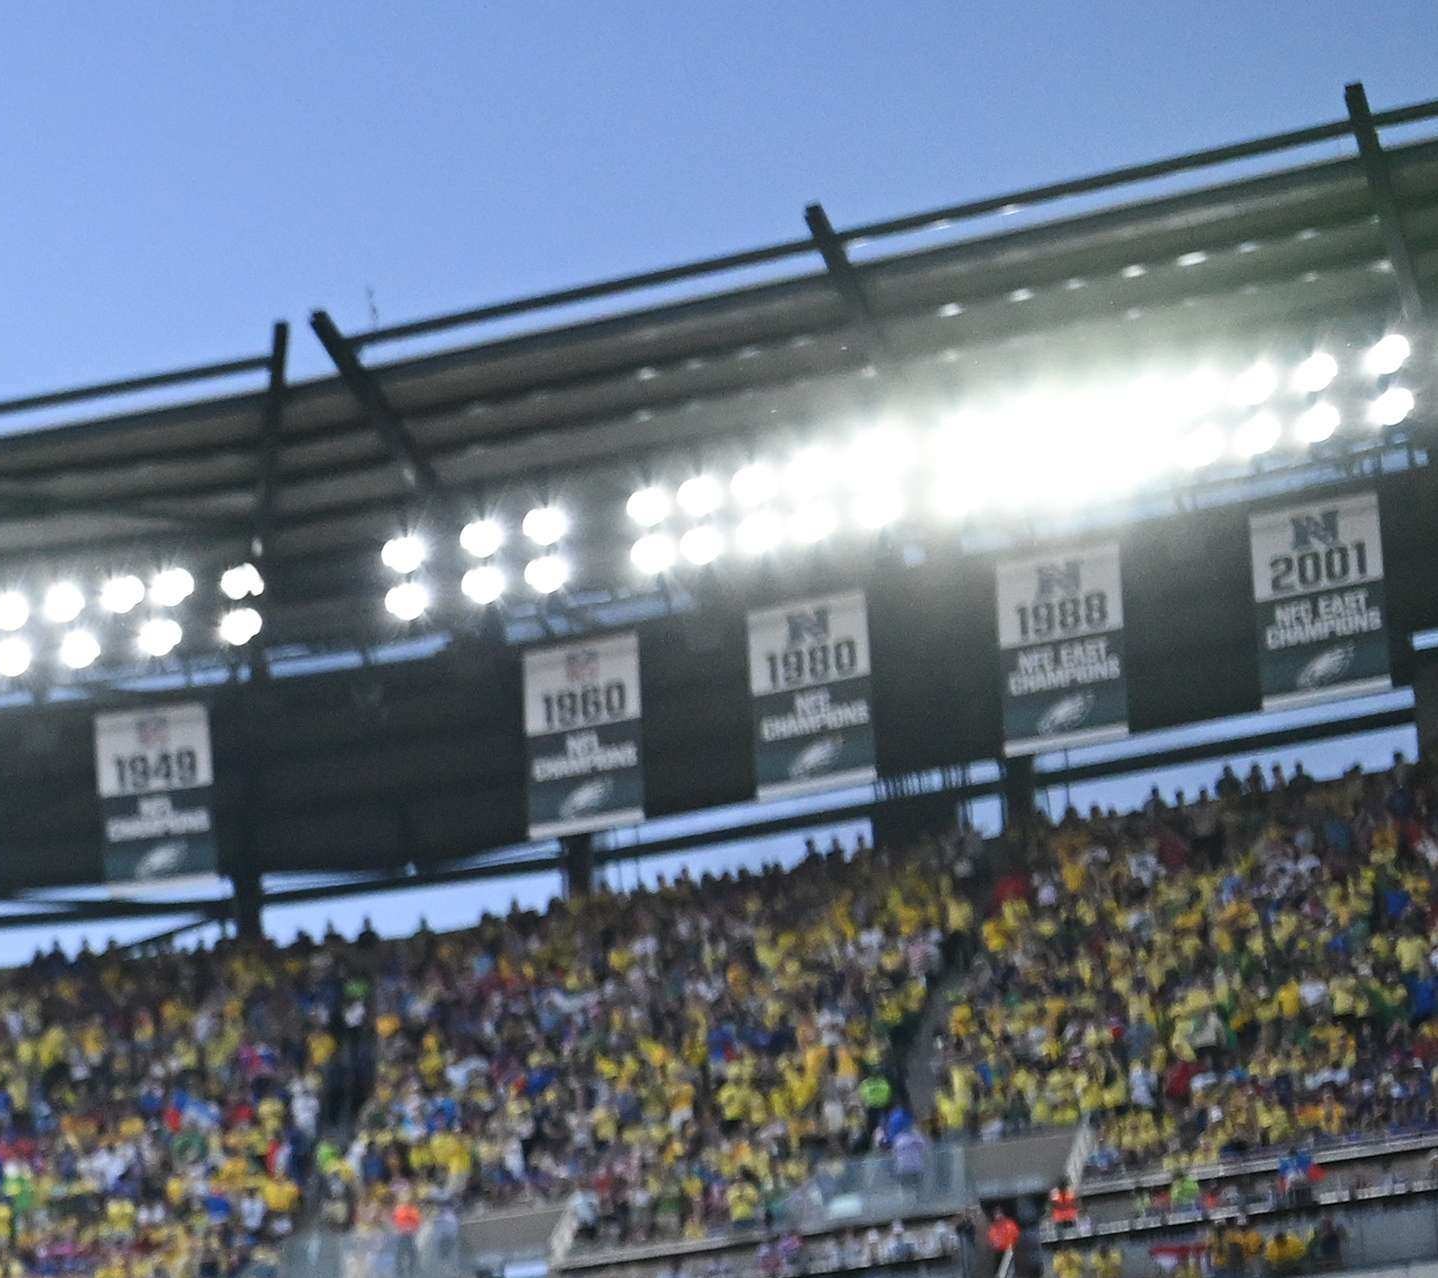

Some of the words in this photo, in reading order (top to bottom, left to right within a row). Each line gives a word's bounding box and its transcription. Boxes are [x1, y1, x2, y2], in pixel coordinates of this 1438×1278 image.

[1269, 542, 1368, 592] 2001
[1016, 591, 1108, 638] 1988
[1318, 589, 1369, 619] EAST
[1266, 606, 1381, 651] CHAMPIONS
[766, 639, 856, 691] 1980
[1008, 654, 1121, 696] CHAMPIONS
[545, 681, 626, 729] 1960
[760, 700, 870, 741] CHAMPIONS
[114, 746, 198, 790] 1949
